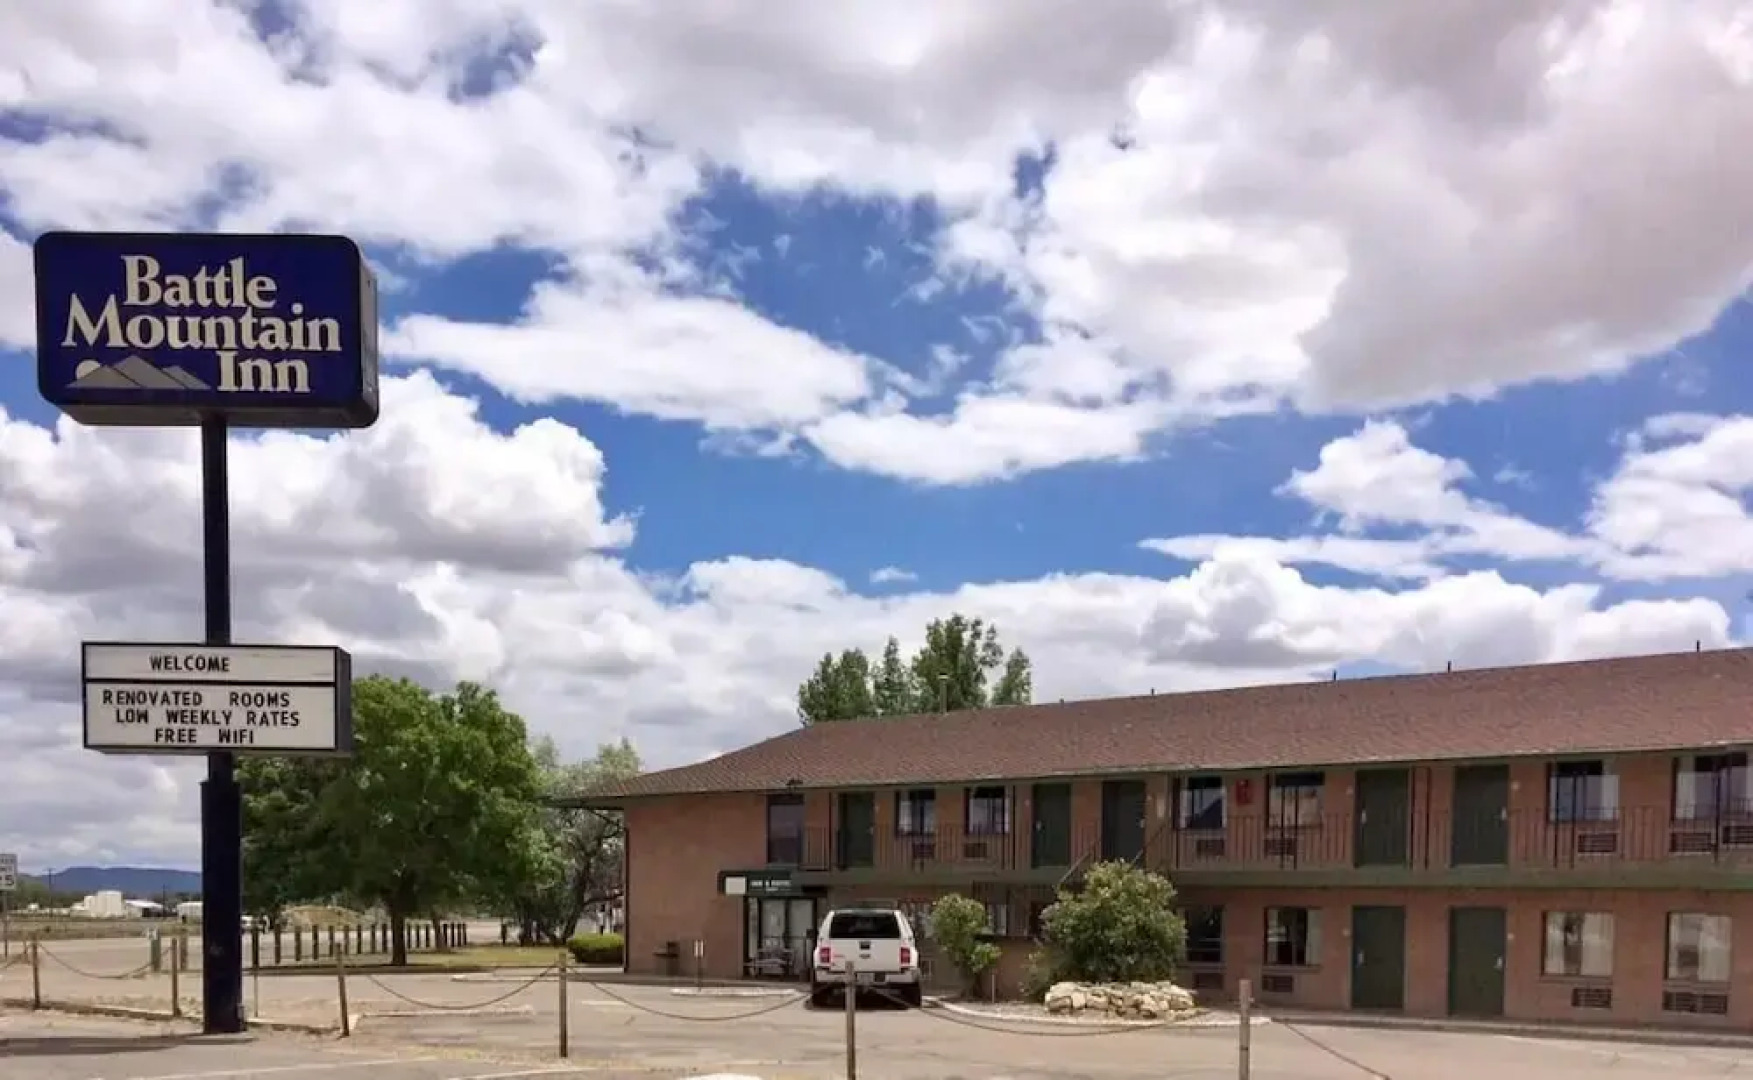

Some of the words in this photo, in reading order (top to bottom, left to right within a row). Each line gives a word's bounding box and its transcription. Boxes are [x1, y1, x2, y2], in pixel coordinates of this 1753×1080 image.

[120, 254, 277, 308] Battle
[61, 293, 342, 352] Mountain
[216, 350, 310, 393] Inn
[149, 655, 230, 672] WELCOME
[102, 690, 202, 706] RENOVATED
[229, 692, 290, 708] ROOMS
[116, 708, 148, 724] LOW
[166, 709, 232, 726] WEEKLY
[246, 711, 299, 727] RATES
[154, 727, 197, 744] FREE
